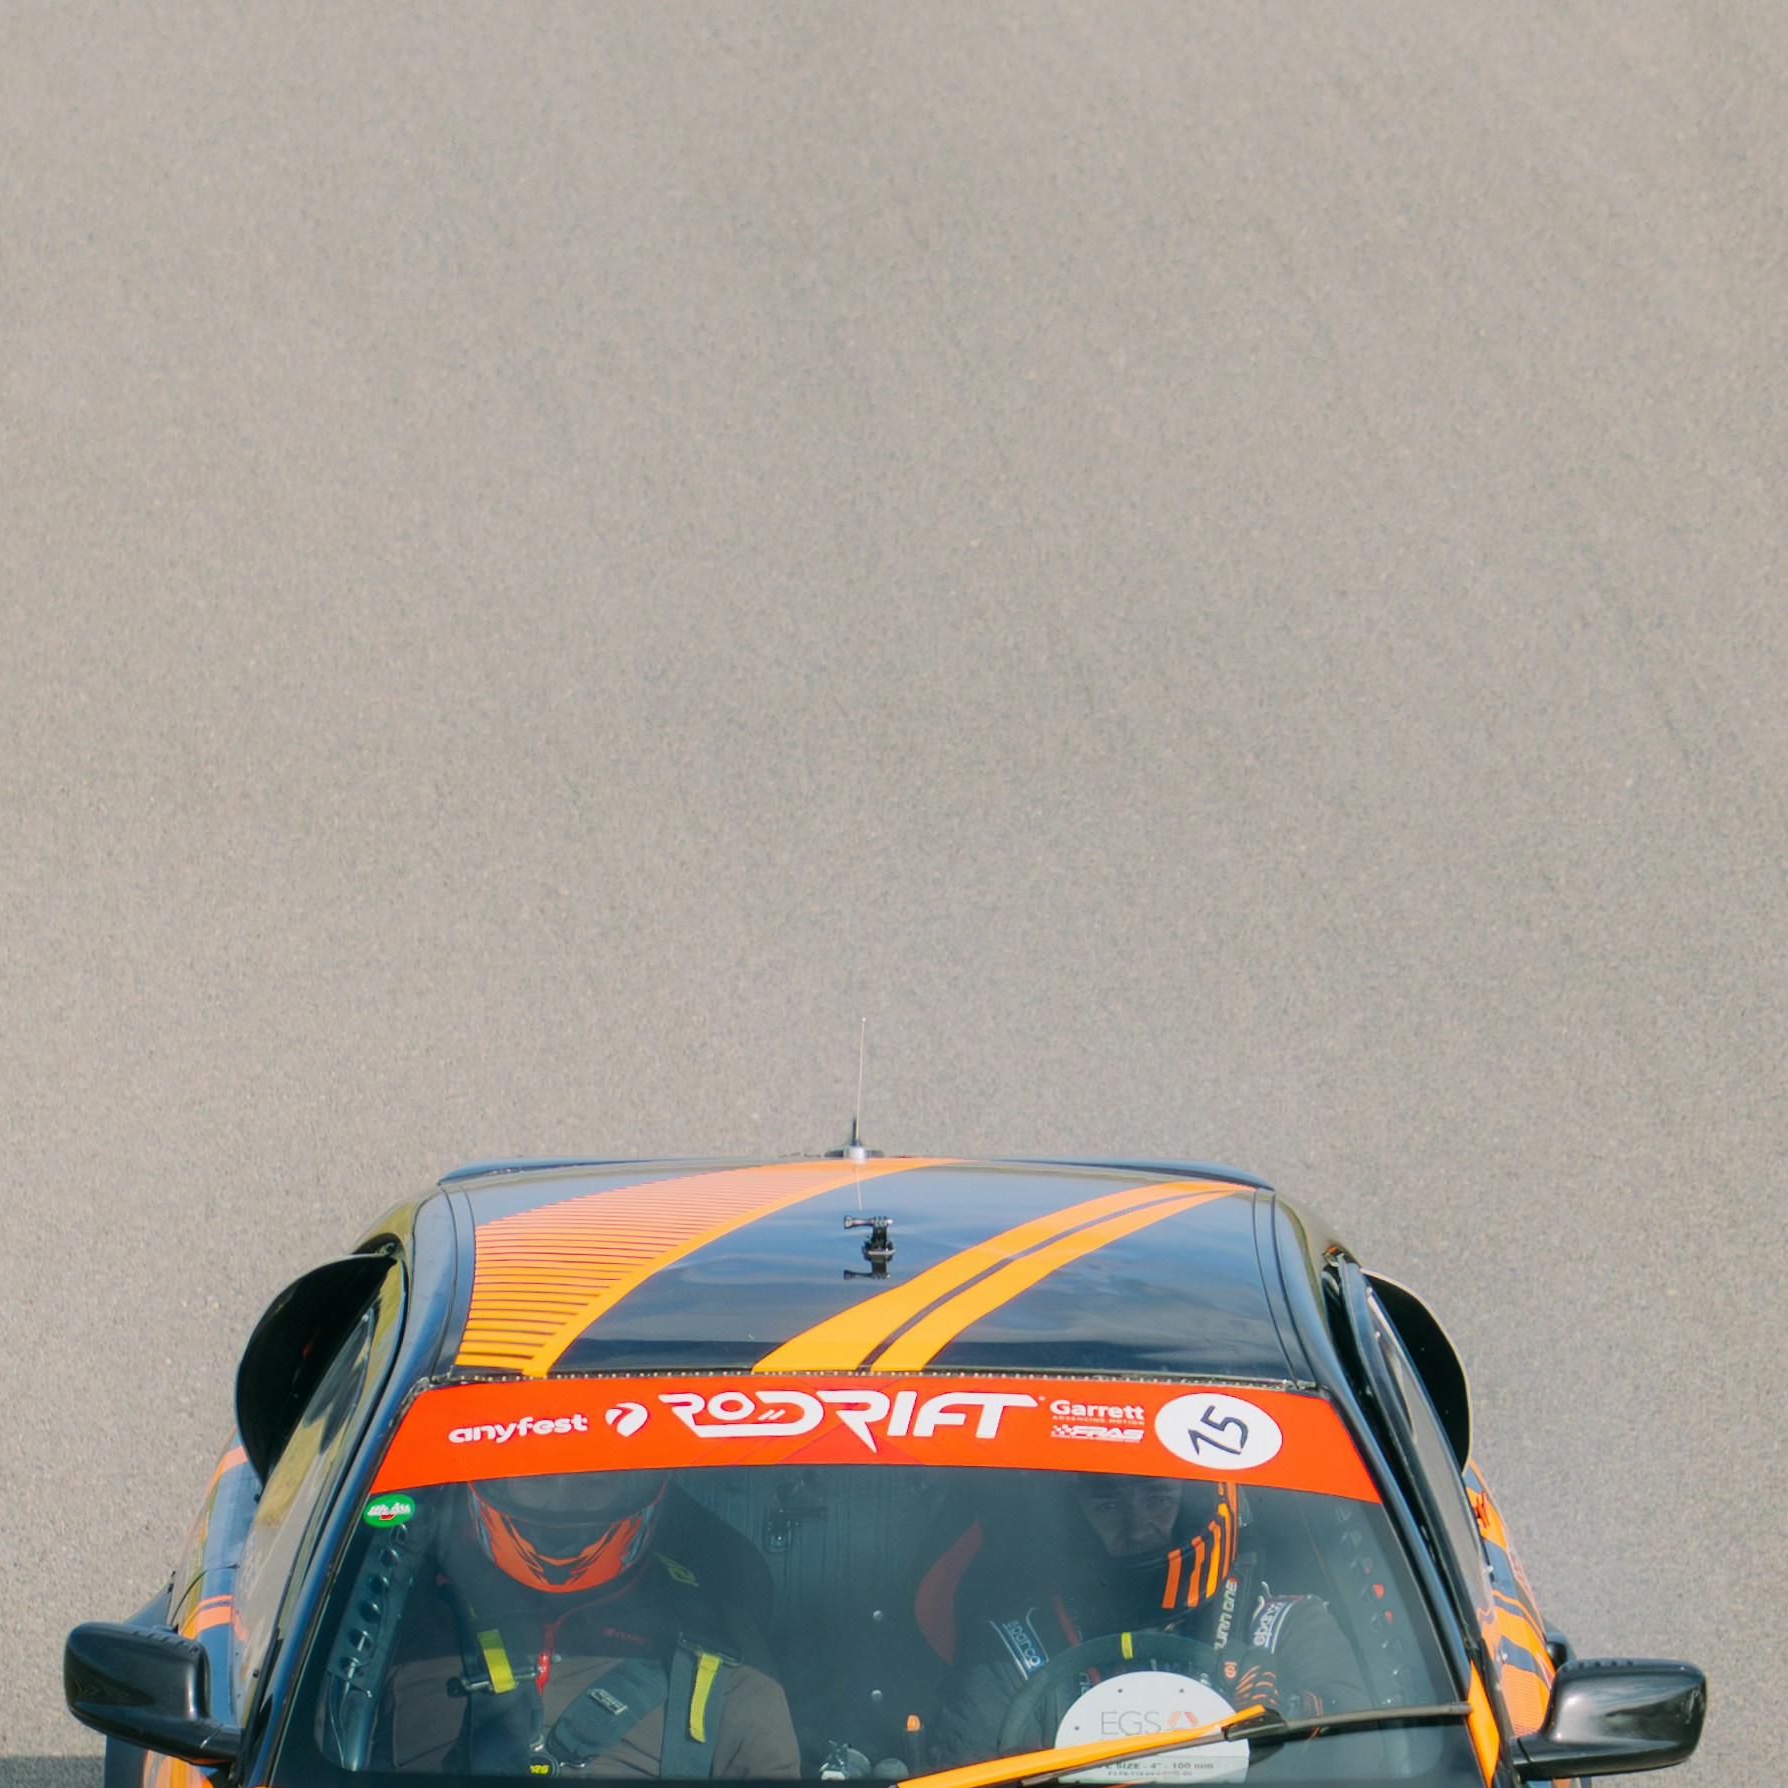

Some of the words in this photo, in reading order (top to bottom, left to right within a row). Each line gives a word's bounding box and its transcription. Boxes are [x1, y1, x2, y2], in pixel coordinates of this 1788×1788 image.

[1050, 1399, 1145, 1420] Garrett
[448, 1413, 588, 1443] anyfest
[1187, 1405, 1250, 1455] 15
[1100, 1710, 1162, 1737] EGS
